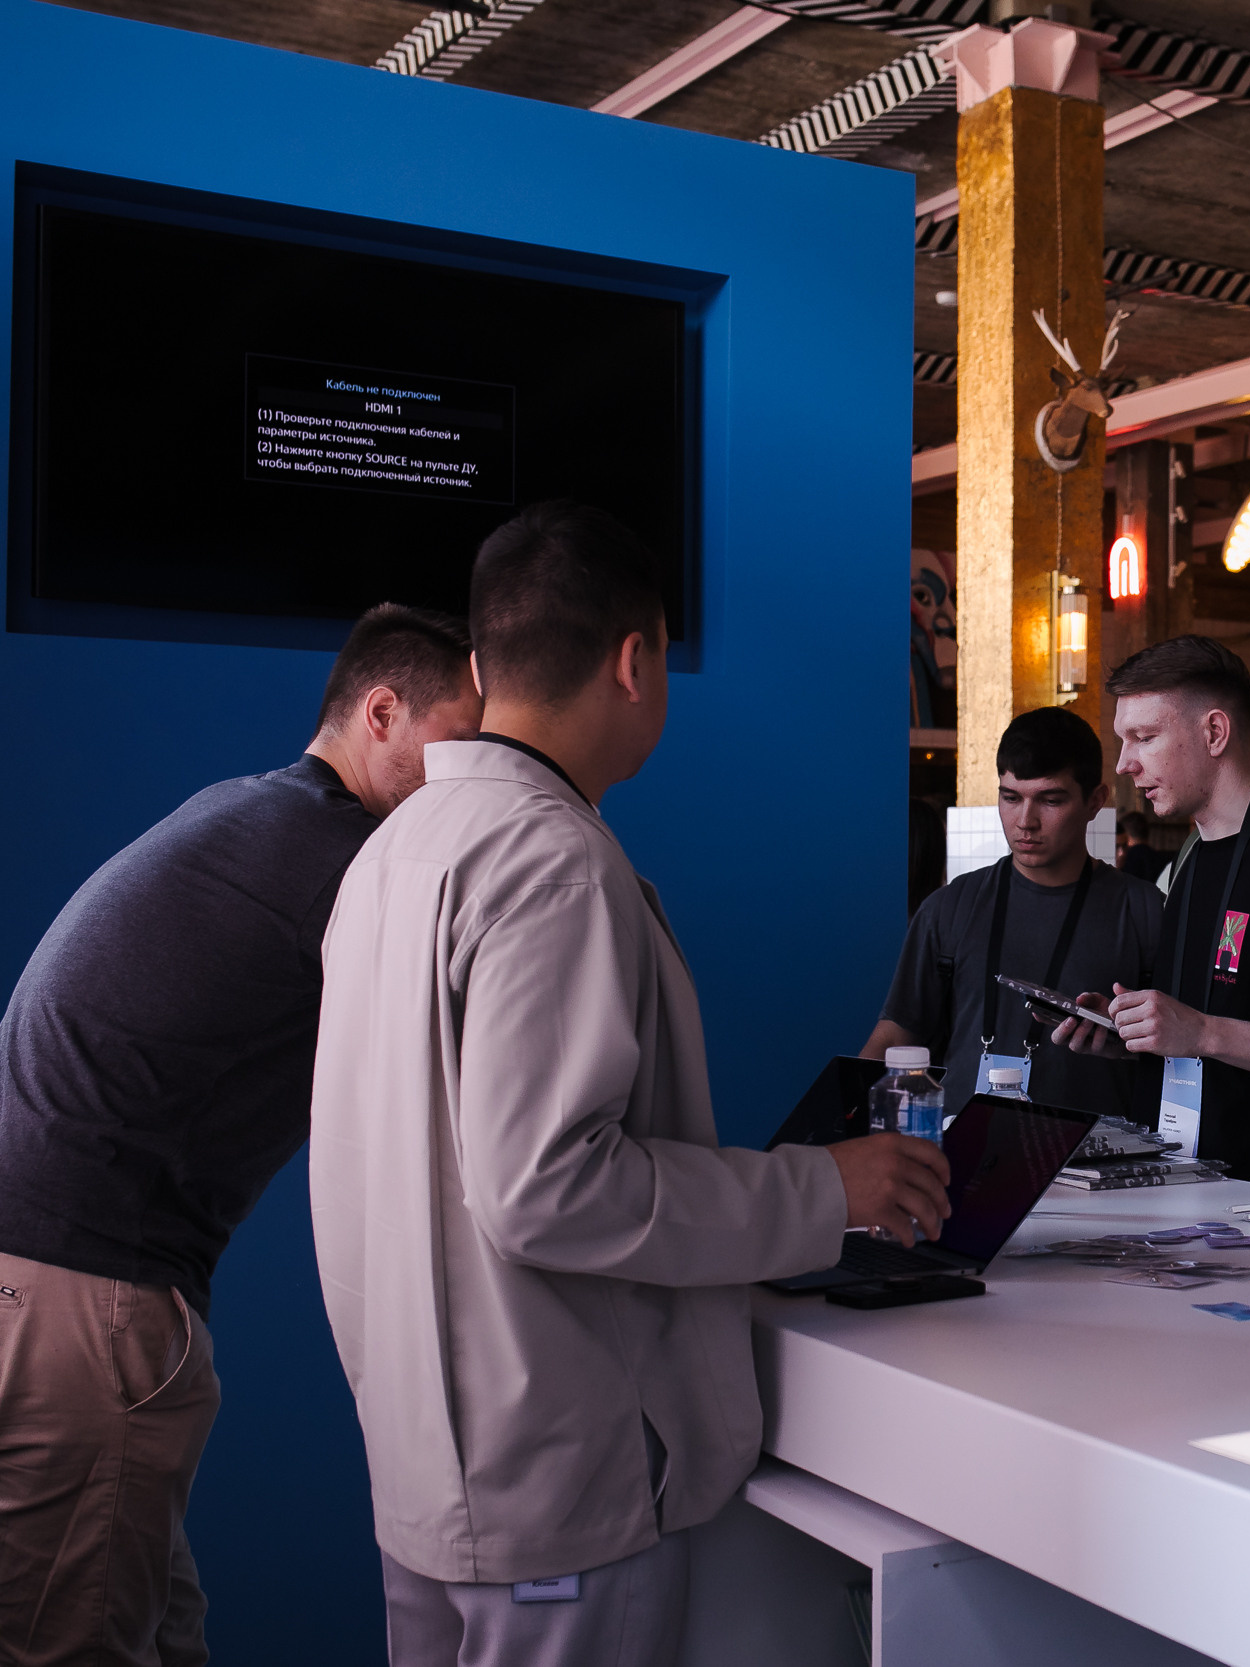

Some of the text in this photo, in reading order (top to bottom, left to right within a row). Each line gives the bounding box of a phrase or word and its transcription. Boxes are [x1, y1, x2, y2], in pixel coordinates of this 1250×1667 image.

[326, 379, 441, 402] Кабель не подключен
[366, 402, 402, 415] HDMI 1
[258, 408, 461, 441] (1) Проверьте подключения кабелей и
[258, 426, 377, 447] параметры источника.
[258, 441, 479, 475] (2) Нажмите кнопку SOURCE на пульте ДУ,
[258, 458, 472, 488] чтобы выбрать подключенный источник.
